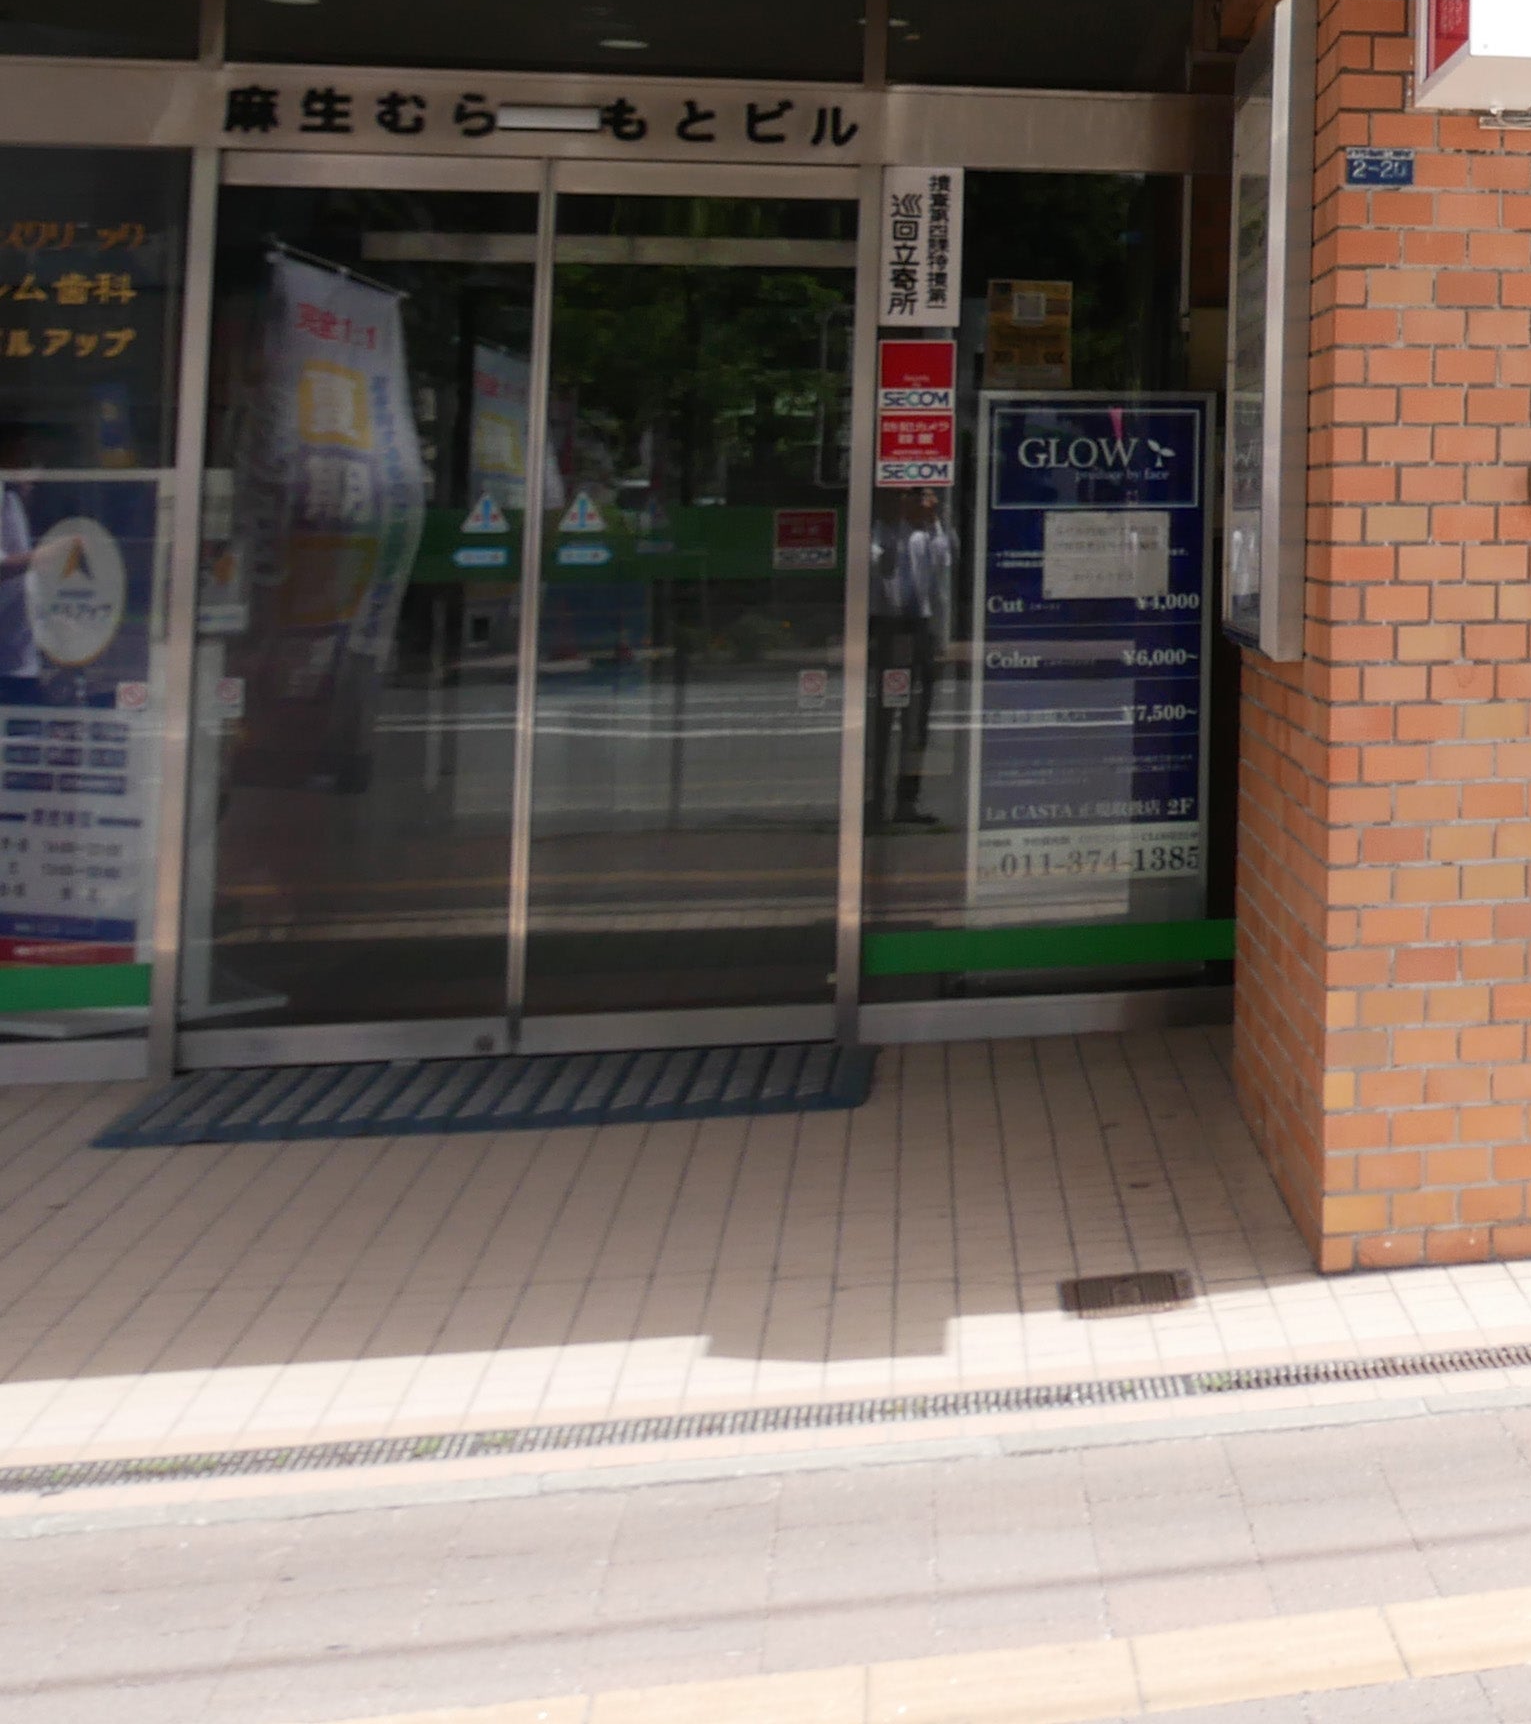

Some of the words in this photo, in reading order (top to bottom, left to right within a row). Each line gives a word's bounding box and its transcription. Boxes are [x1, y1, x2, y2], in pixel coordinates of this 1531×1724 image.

[888, 193, 922, 316] 巡回立寄所
[884, 391, 949, 406] SECOM
[1018, 437, 1138, 469] GLOW
[882, 464, 947, 479] SECOM
[987, 597, 1023, 613] Cut
[986, 652, 1042, 669] Color
[1166, 797, 1195, 816] 2F
